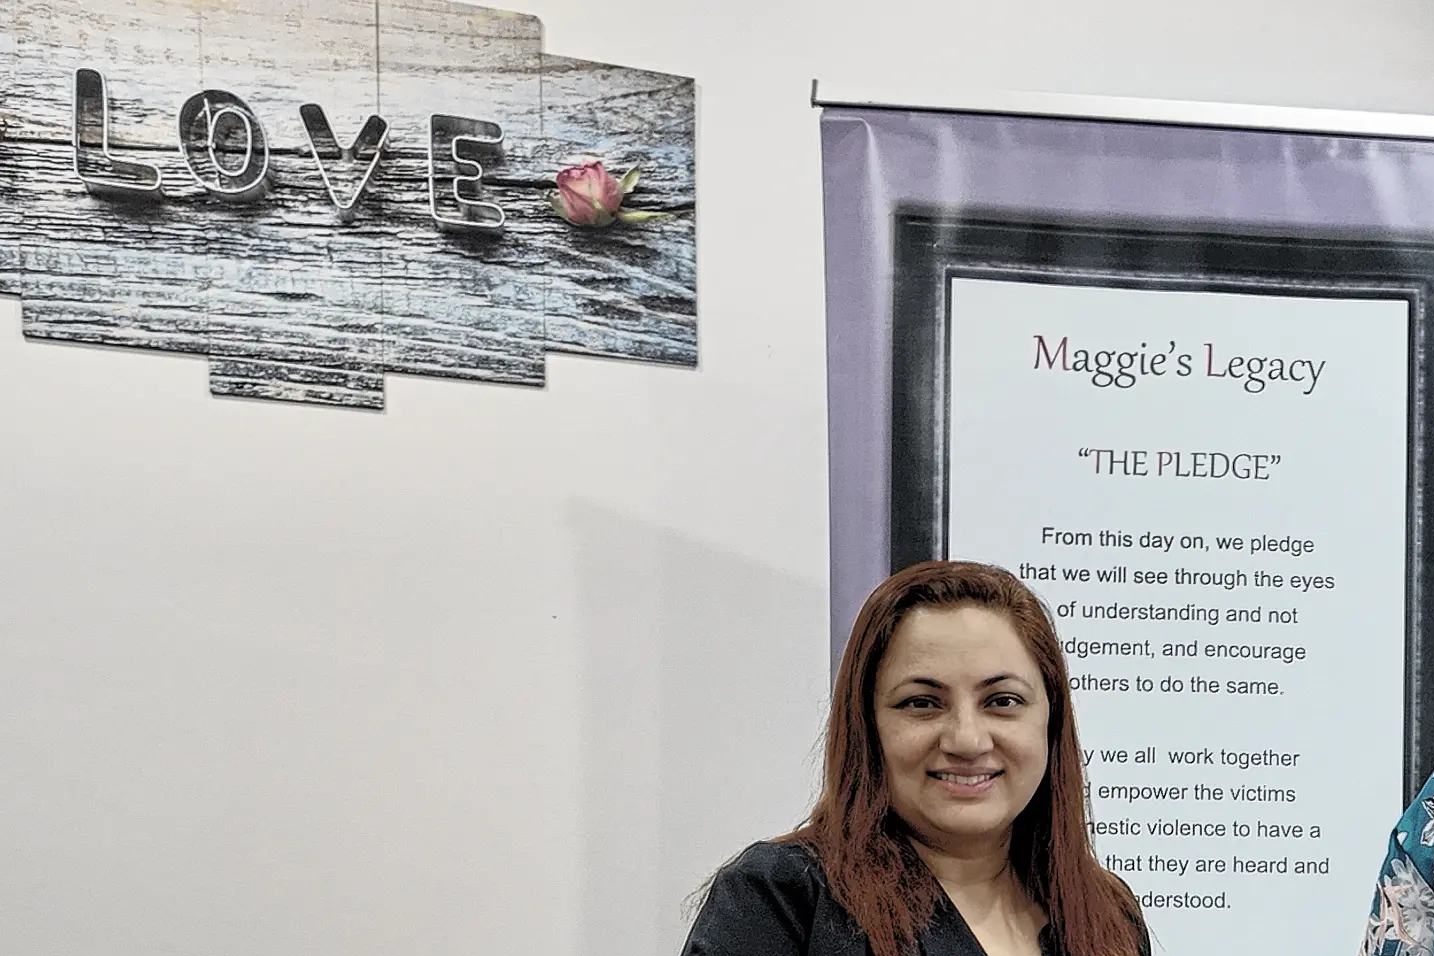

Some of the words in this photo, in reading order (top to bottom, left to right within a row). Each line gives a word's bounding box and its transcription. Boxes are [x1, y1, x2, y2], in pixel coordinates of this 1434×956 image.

[73, 67, 505, 230] LOVE
[1032, 334, 1193, 389] Maggie’s
[1203, 342, 1327, 396] Legacy
[1077, 447, 1149, 477] “THE
[1155, 451, 1282, 481] PLEDGE”
[1041, 526, 1093, 547] From
[1098, 529, 1134, 548] this
[1138, 530, 1175, 553] day
[1179, 535, 1210, 553] on,
[1215, 536, 1244, 551] we
[1250, 534, 1315, 557] pledge
[1018, 562, 1057, 583] that
[1061, 568, 1091, 583] we
[1095, 565, 1127, 584] will
[1132, 570, 1169, 585] see
[1173, 567, 1248, 591] through
[1253, 570, 1284, 589] the
[1289, 575, 1336, 593] eyes
[1056, 600, 1078, 618] of
[1082, 601, 1220, 626] understanding
[1225, 605, 1262, 623] and
[1268, 607, 1299, 624] not
[1061, 637, 1155, 658] dgement,
[1161, 640, 1198, 658] and
[1204, 644, 1307, 665] encourage
[1069, 674, 1129, 691] others
[1135, 675, 1154, 693] to
[1159, 675, 1184, 693] do
[1189, 676, 1221, 694] the
[1226, 680, 1285, 696] same.
[1100, 749, 1129, 764] we
[1134, 746, 1156, 764] all
[1167, 747, 1215, 765] work
[1219, 748, 1301, 770] together
[1097, 785, 1189, 804] empower
[1193, 783, 1224, 801] the
[1229, 784, 1297, 803] victims
[1087, 820, 1141, 836] estic
[1146, 818, 1227, 837] violence
[1231, 820, 1251, 838] to
[1257, 820, 1304, 839] have
[1309, 825, 1321, 839] a
[1105, 853, 1143, 873] that
[1147, 854, 1190, 877] they
[1195, 859, 1227, 874] are
[1232, 855, 1288, 874] heard
[1293, 857, 1330, 875] and
[1135, 891, 1231, 909] derstood.
